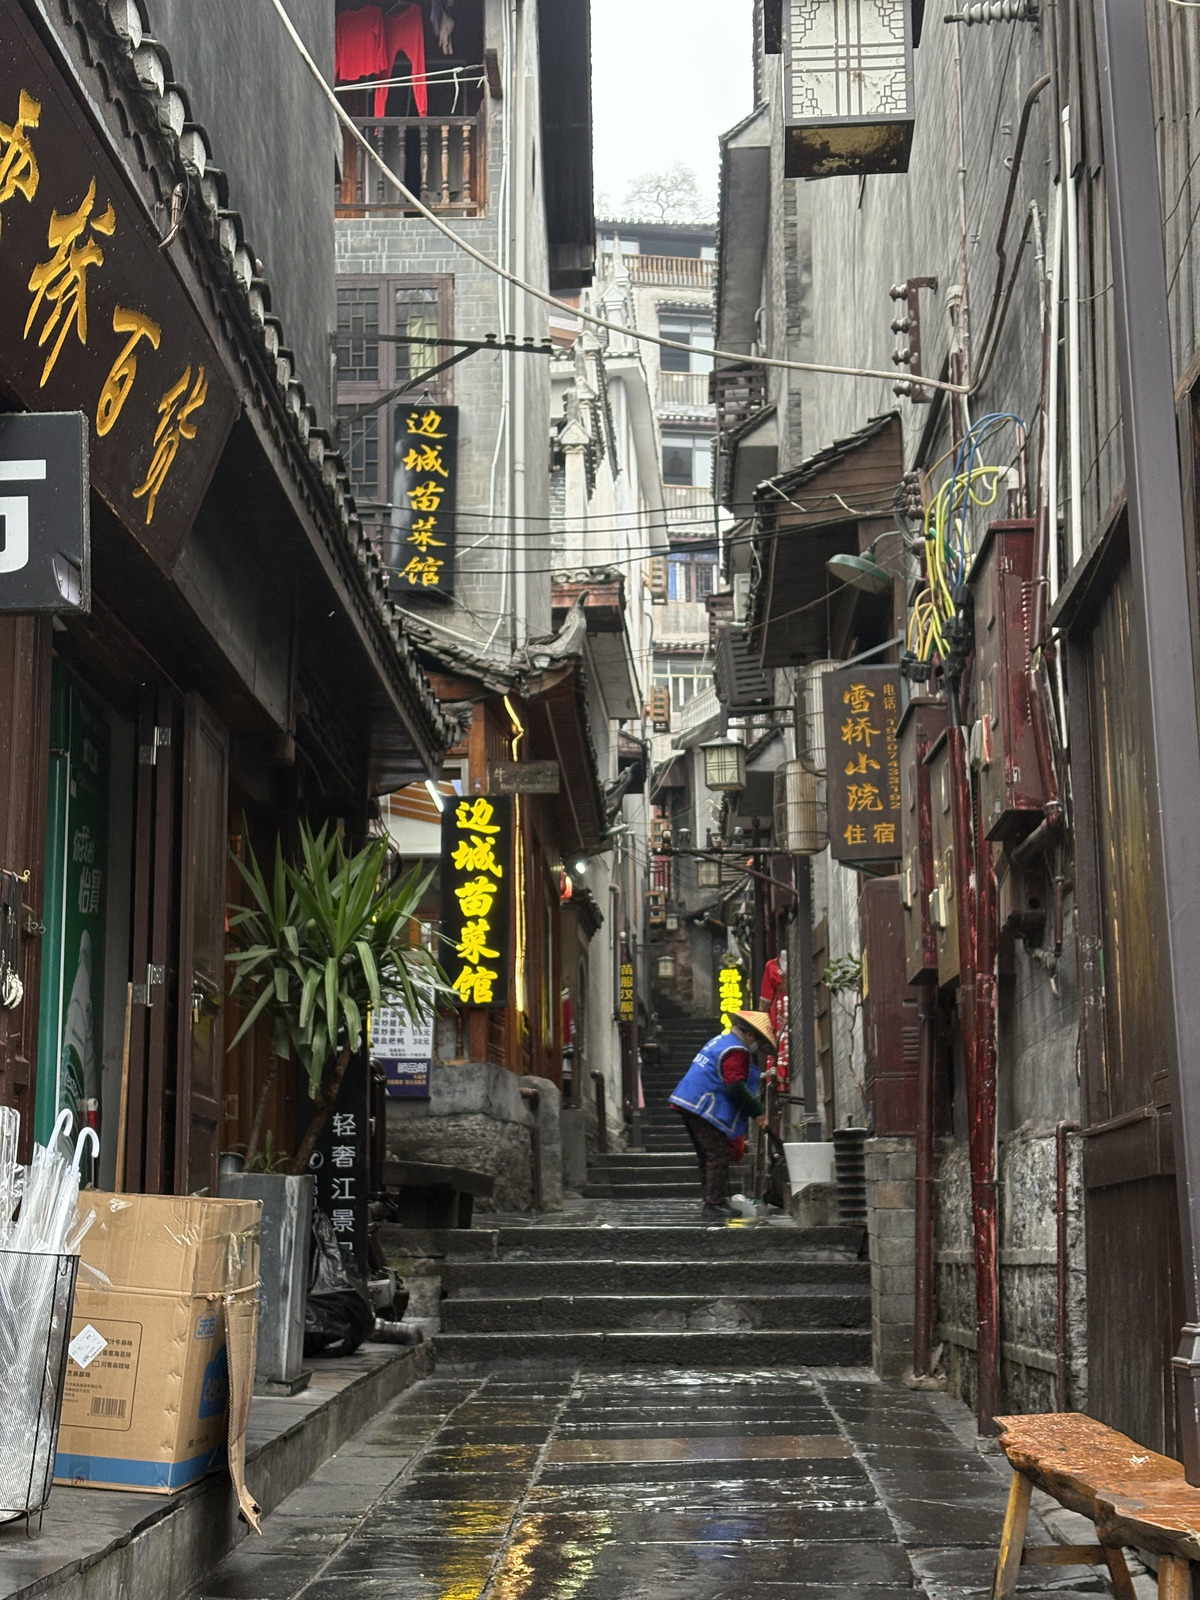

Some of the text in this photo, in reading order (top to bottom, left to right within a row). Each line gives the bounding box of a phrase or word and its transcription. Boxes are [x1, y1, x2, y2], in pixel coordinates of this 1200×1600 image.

[399, 409, 449, 587] 边城苗菜馆
[841, 683, 883, 811] 雪桥小院
[451, 798, 503, 1004] 边城苗菜馆
[413, 1037, 431, 1045] 38元
[620, 963, 634, 1013] 苗服汉服
[331, 1112, 357, 1255] 轻奢江景
